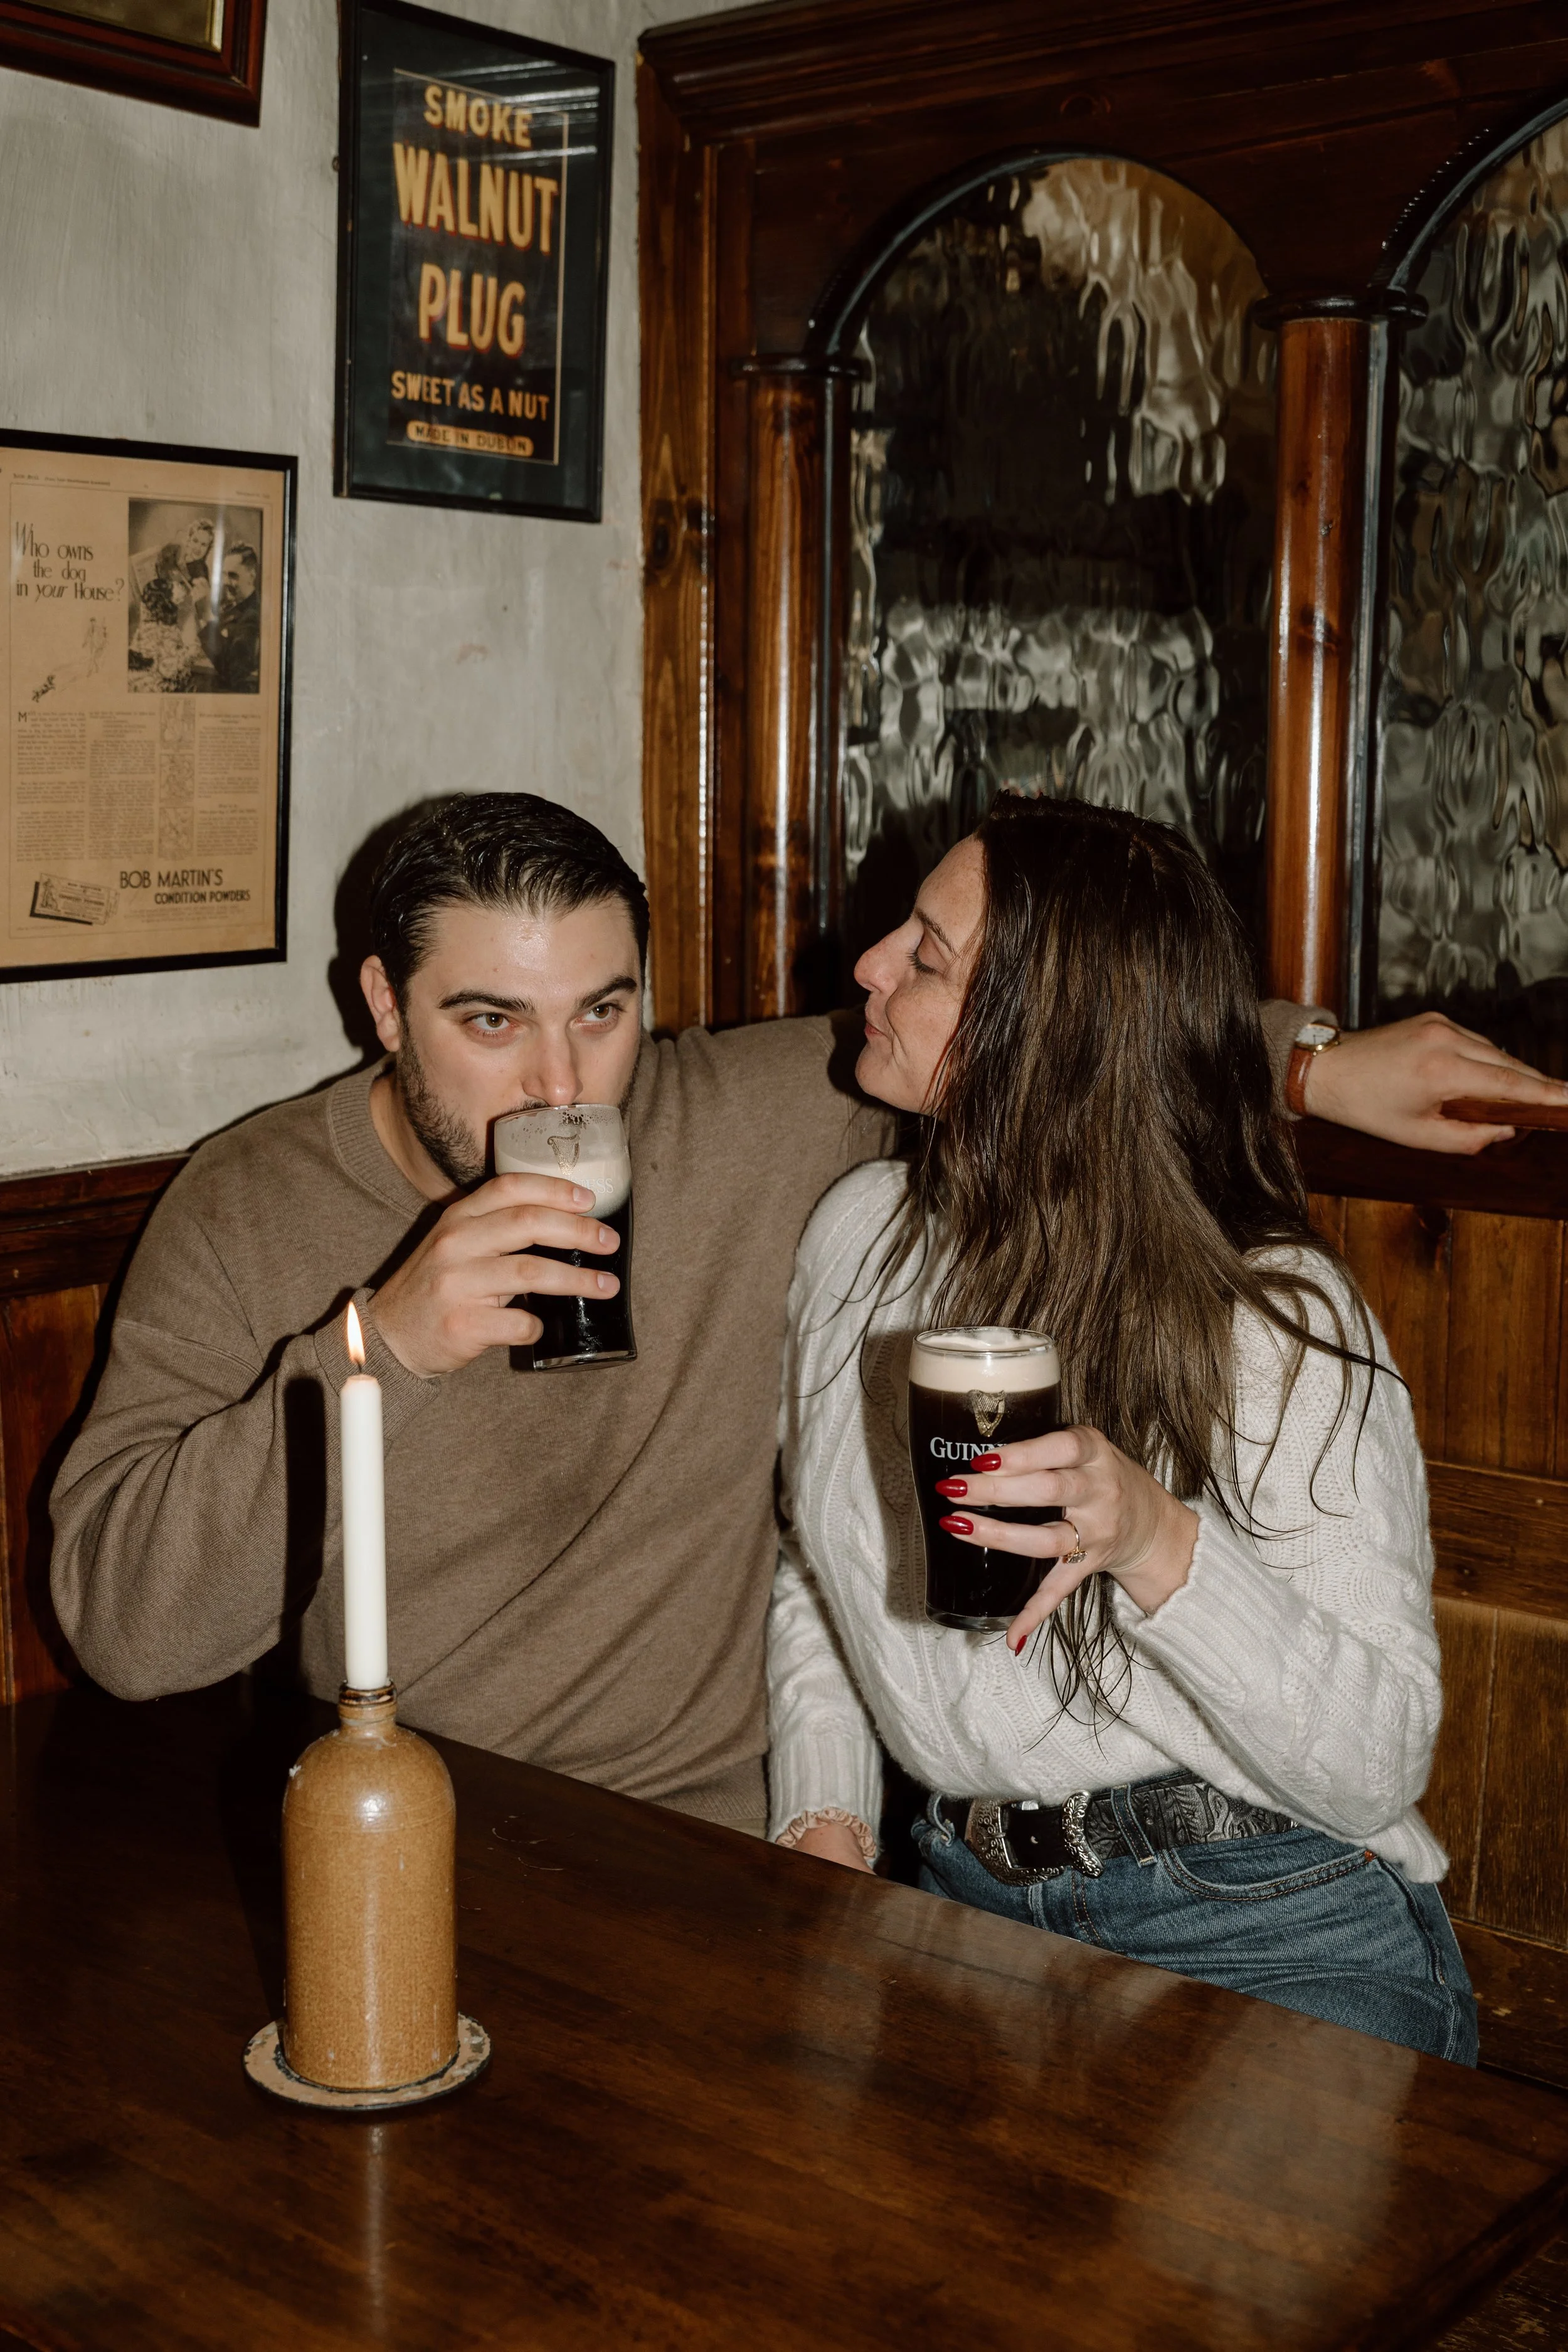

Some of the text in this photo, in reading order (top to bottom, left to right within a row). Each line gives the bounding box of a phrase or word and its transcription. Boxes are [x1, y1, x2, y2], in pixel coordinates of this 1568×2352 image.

[423, 84, 533, 150] SMOKE
[393, 141, 558, 255] WALNUT
[418, 262, 527, 358] PLUG
[391, 370, 550, 421] SWEET AS A NUT
[415, 424, 527, 452] MADE IN DUBLIN
[16, 521, 93, 561] Who owns
[33, 559, 86, 583] the dog
[16, 577, 125, 602] in your House?
[120, 869, 224, 889] BOB MARTIN'S
[154, 889, 250, 904] CONDITION POWDERS
[930, 1437, 1006, 1461] GUIN
